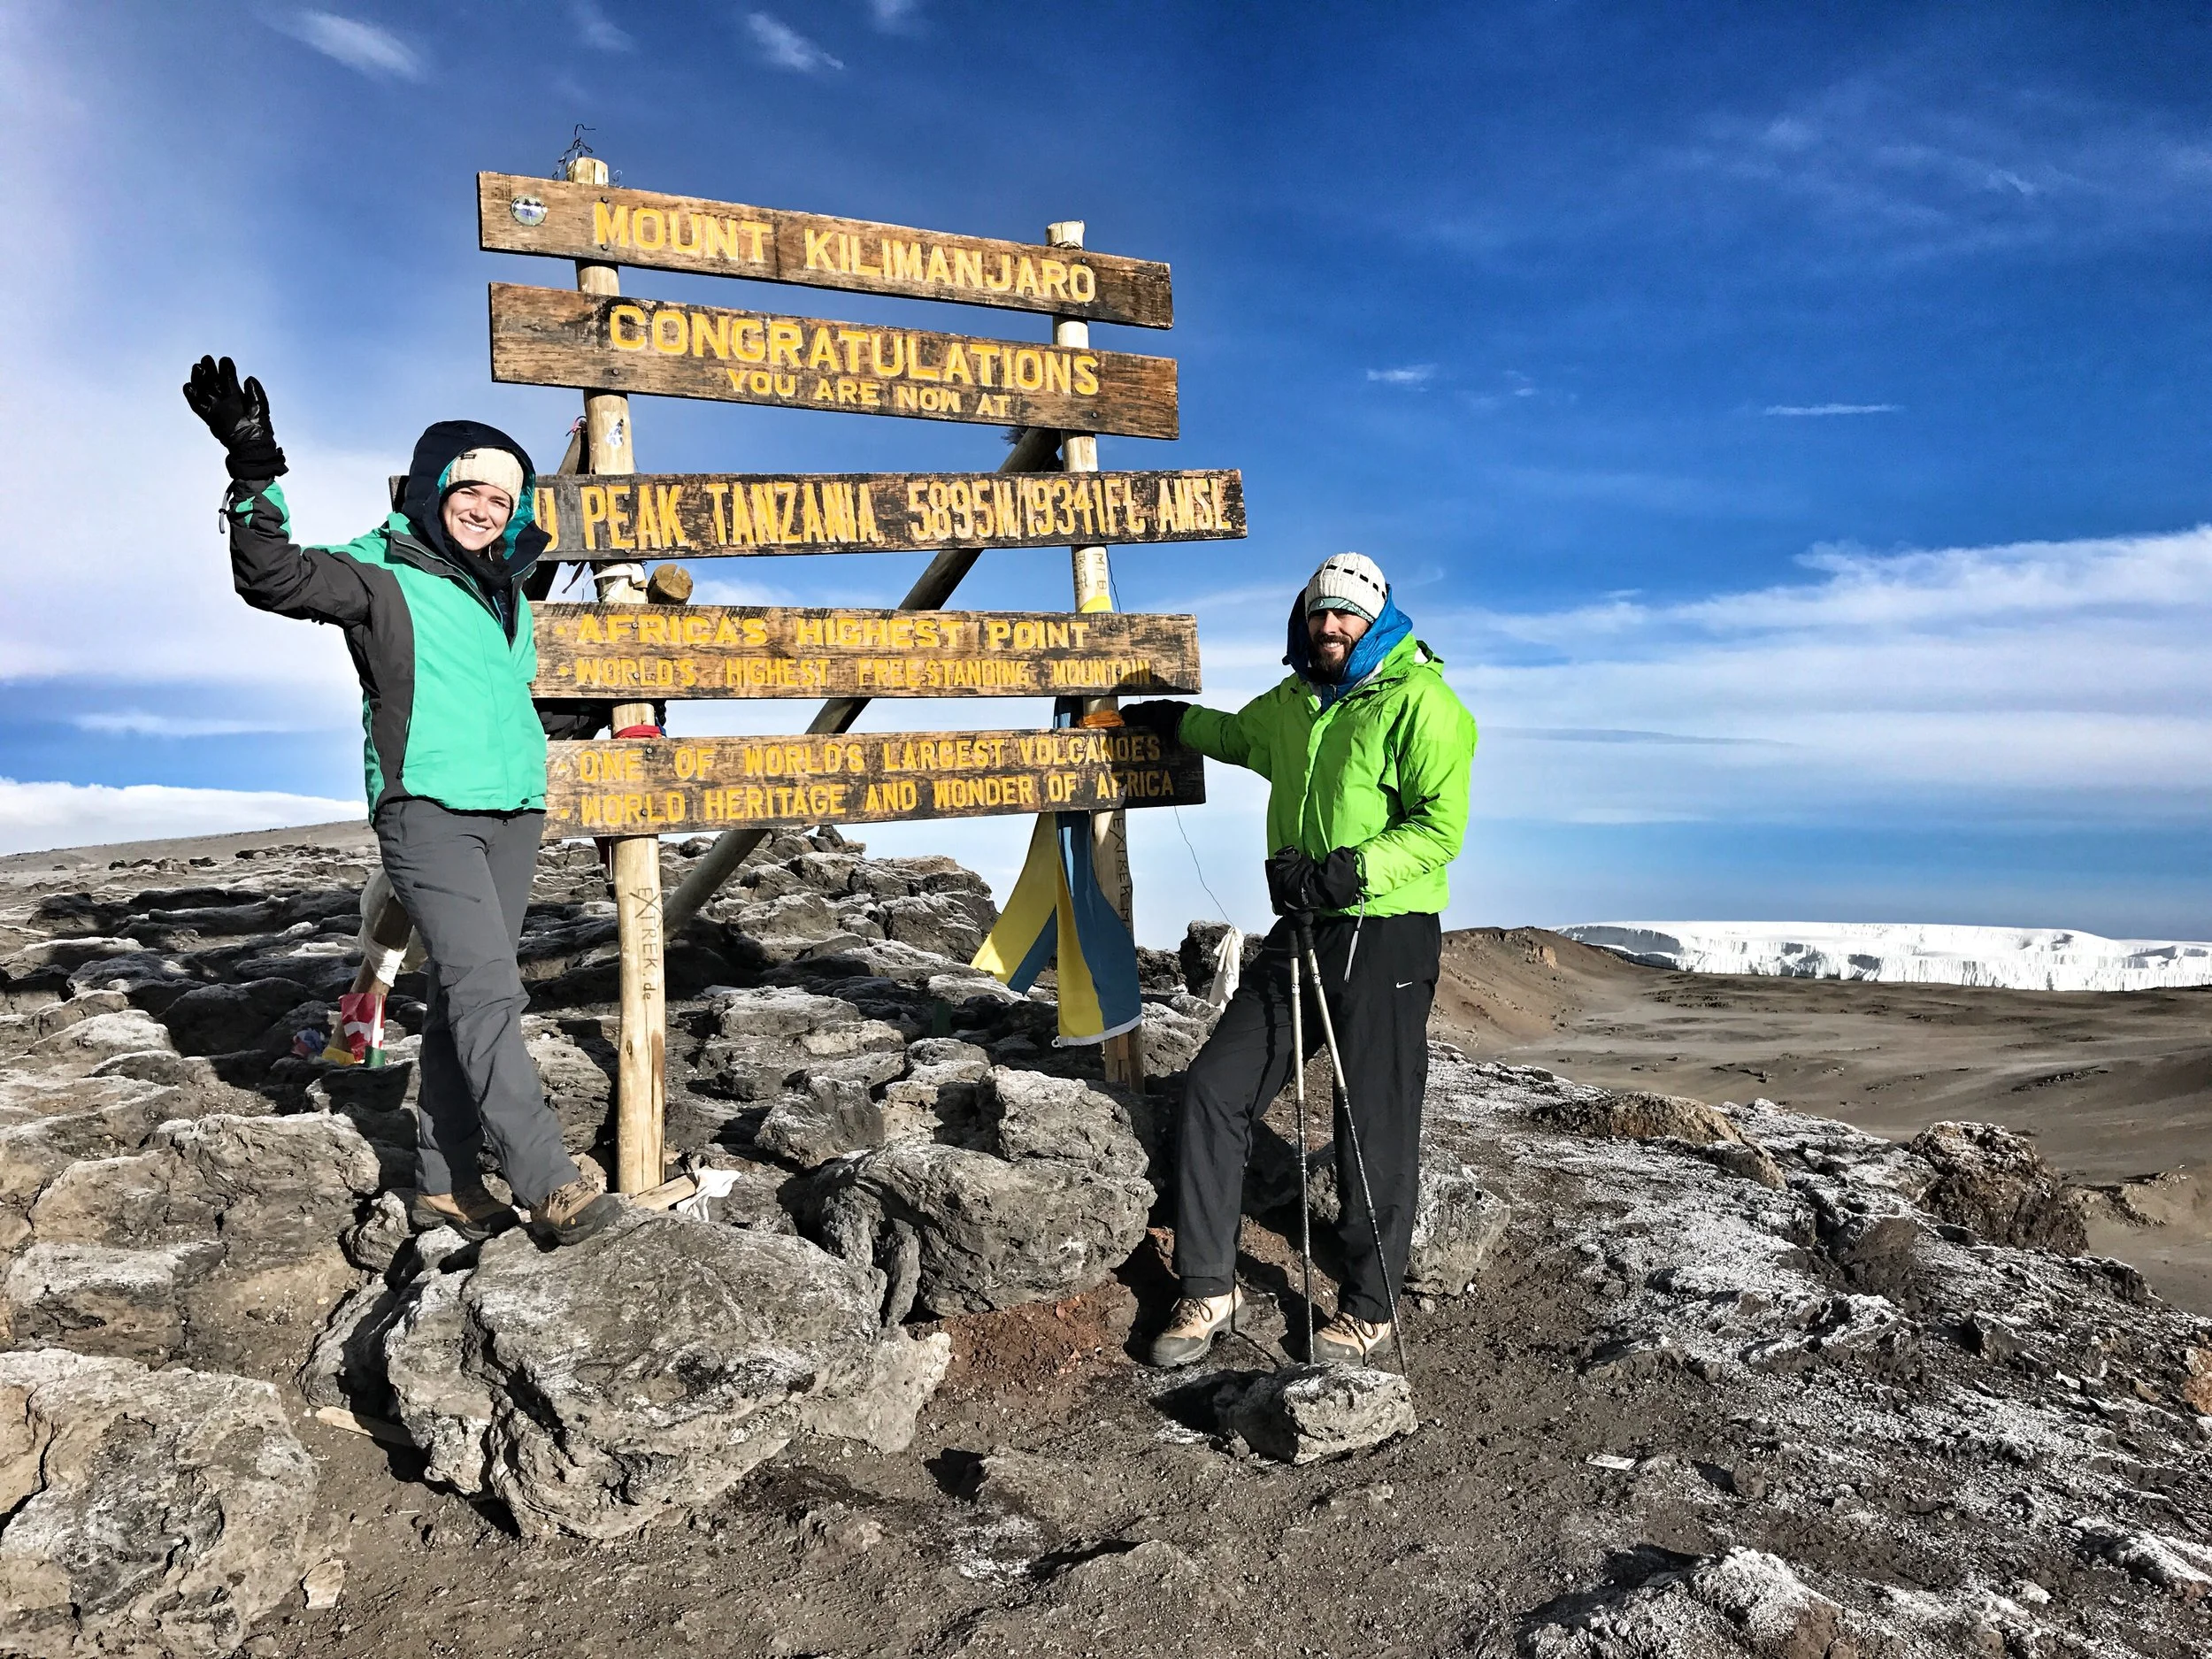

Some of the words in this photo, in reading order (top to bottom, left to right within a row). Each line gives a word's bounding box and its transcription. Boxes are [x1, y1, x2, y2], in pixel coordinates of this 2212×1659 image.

[594, 201, 772, 263] MOUNT
[803, 228, 1095, 303] KILIMANJARO
[610, 304, 1099, 396] CONGRATULATIONS
[726, 367, 795, 396] YOU
[813, 378, 881, 406] ARE
[895, 384, 962, 413] NOW
[976, 393, 1011, 418] AT
[580, 483, 689, 550] PEAK
[706, 481, 880, 546] TANZANIA
[1158, 477, 1232, 533] AMSL
[797, 618, 964, 649] HIGHEST
[987, 621, 1090, 649] POINT
[726, 657, 832, 687] HIGHEST
[1052, 658, 1151, 687] MOUNTAIN
[580, 749, 644, 784] ONE
[675, 747, 716, 780] OF
[883, 738, 1005, 772] LARGEST
[1019, 735, 1161, 766] VOLCANOES
[580, 790, 686, 827] WORLD
[704, 783, 847, 820] HERITAGE
[864, 780, 918, 812] AND
[933, 774, 1034, 809] WONDER
[1048, 772, 1078, 803] OF
[1096, 769, 1175, 800] AFRICA
